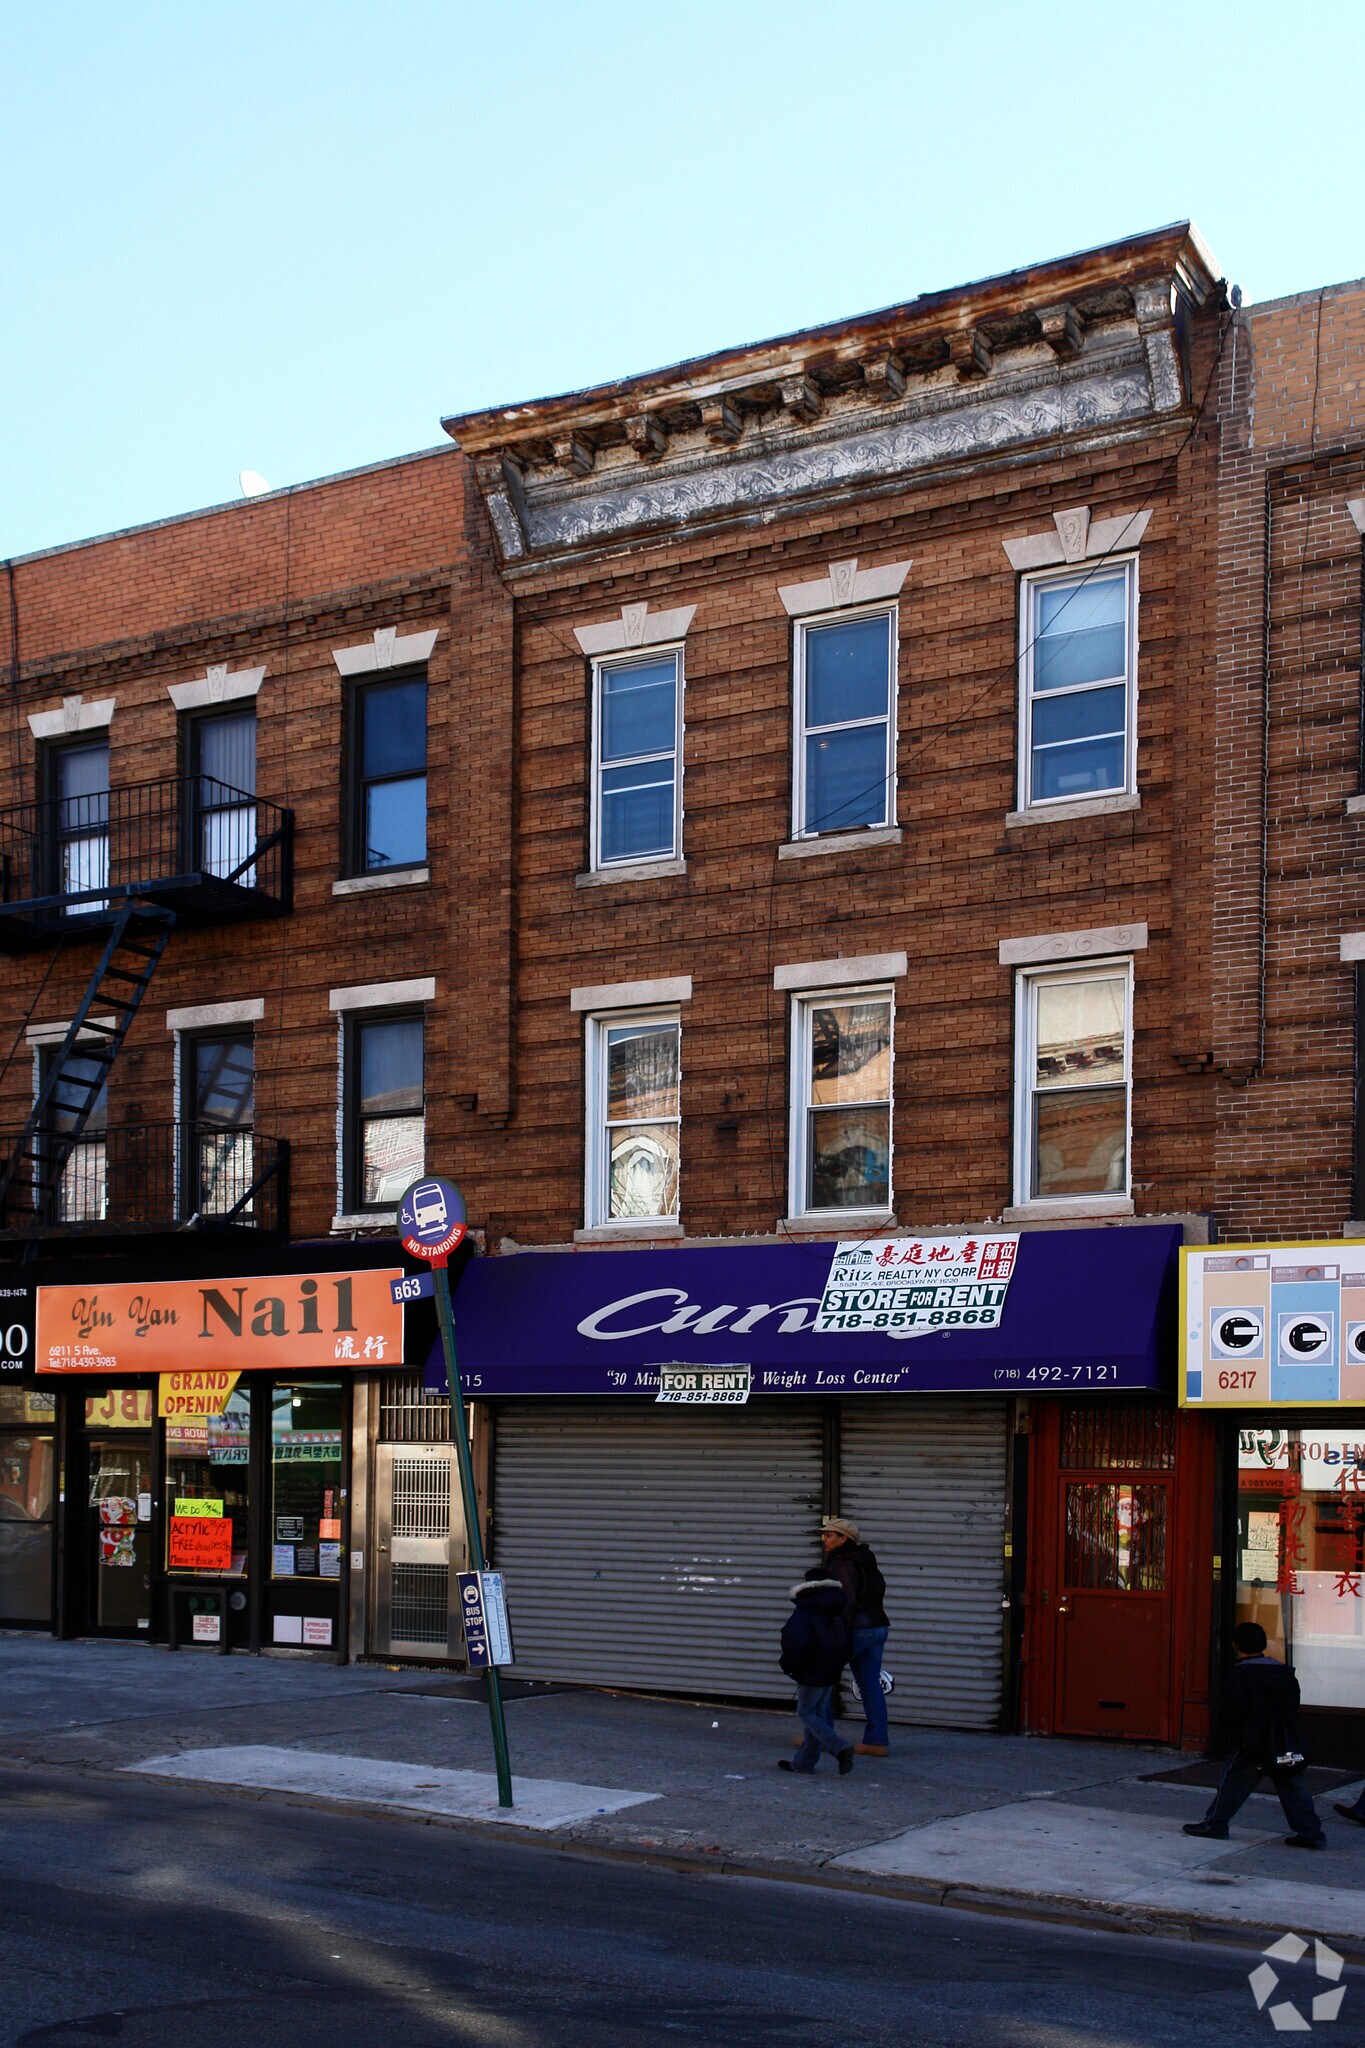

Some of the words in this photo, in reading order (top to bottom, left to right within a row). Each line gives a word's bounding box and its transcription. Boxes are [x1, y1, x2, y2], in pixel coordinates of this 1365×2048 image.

[407, 1239, 420, 1253] NO
[421, 1227, 461, 1257] STANDING
[832, 1267, 873, 1282] Ritz
[877, 1269, 921, 1281] REALTY
[924, 1268, 942, 1278] NY
[944, 1267, 977, 1277] CORP.
[394, 1278, 421, 1300] B63
[826, 1289, 911, 1311] STORE
[910, 1291, 934, 1306] FOR
[933, 1285, 1006, 1307] RENT
[71, 1296, 116, 1339] Yin
[128, 1295, 180, 1337] Yan
[198, 1277, 358, 1337] Nail
[577, 1288, 821, 1340] Curv
[821, 1309, 996, 1329] 718-851-8868
[0, 1324, 28, 1356] 0
[74, 1347, 80, 1356] 5
[170, 1372, 229, 1391] GRAND
[445, 1374, 482, 1387] 15
[664, 1374, 697, 1389] FOR
[702, 1374, 747, 1389] RENT
[763, 1371, 807, 1388] Weight
[815, 1370, 846, 1385] Loss
[994, 1369, 1020, 1380] (718)
[1026, 1365, 1117, 1381] 492-7121
[1218, 1370, 1257, 1389] 6217
[661, 1392, 744, 1402] 718-851-8868
[465, 1606, 481, 1616] BUS
[465, 1617, 484, 1627] STOP
